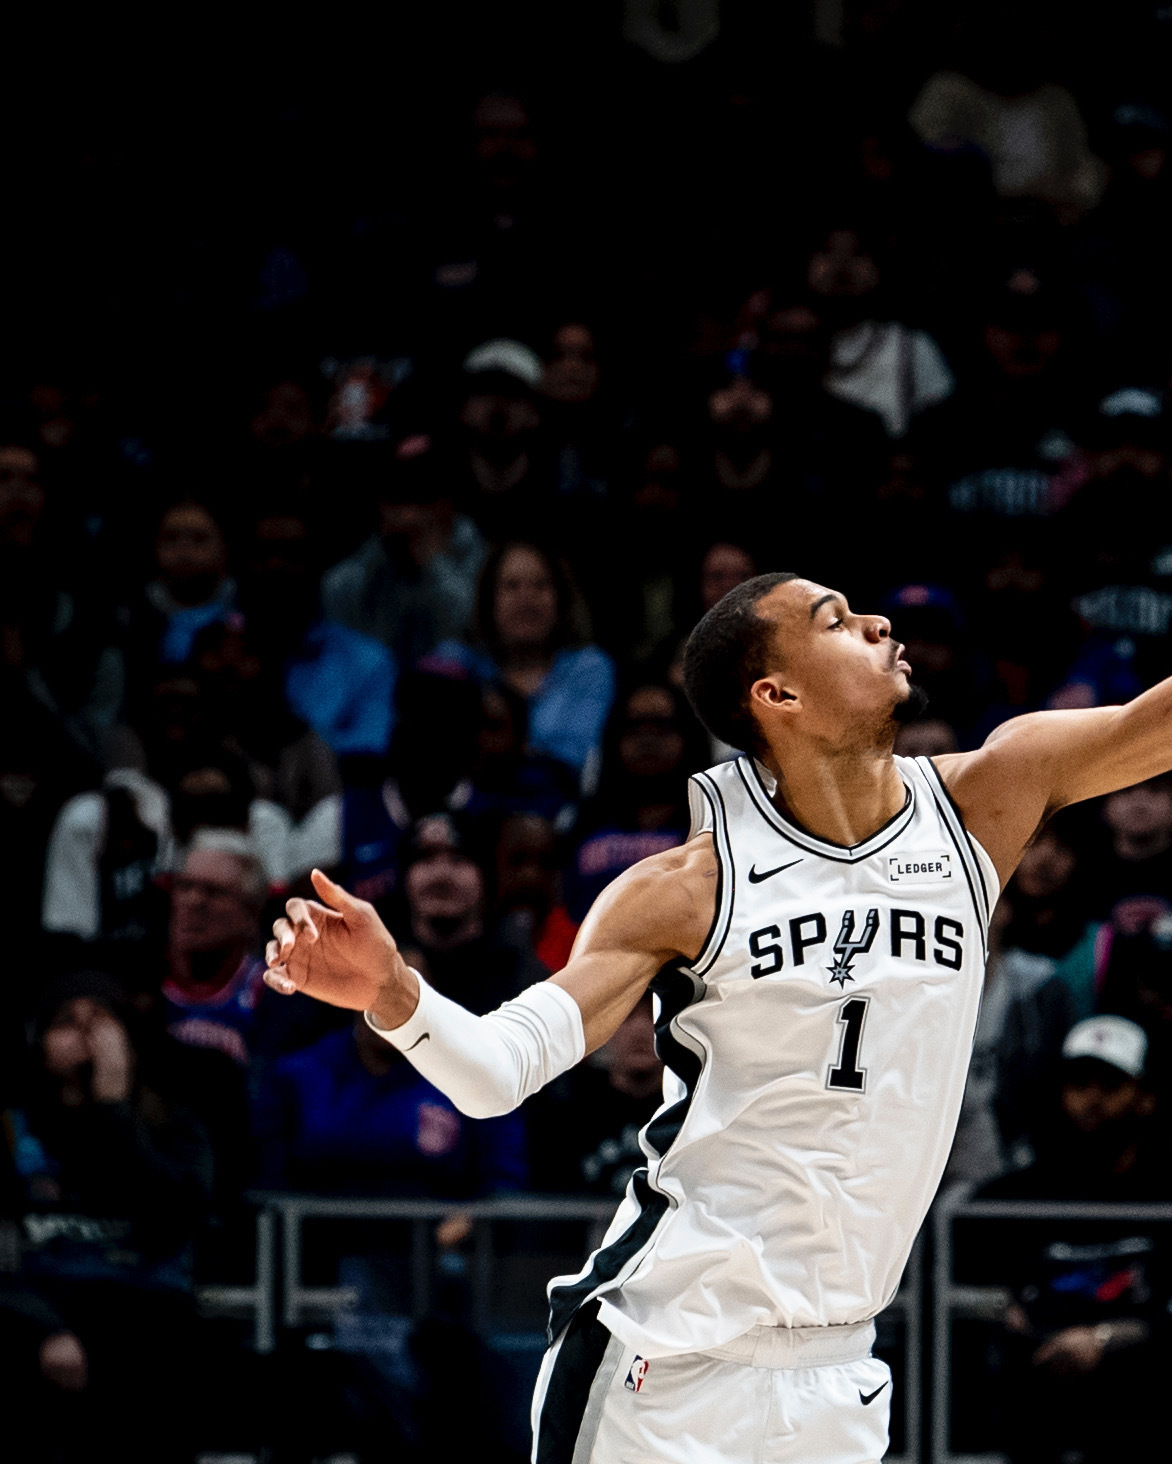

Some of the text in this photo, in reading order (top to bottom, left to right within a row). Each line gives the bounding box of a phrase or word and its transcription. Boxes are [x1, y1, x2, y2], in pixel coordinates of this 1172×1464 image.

[897, 862, 943, 875] LEDGER
[748, 908, 964, 989] SPURS
[825, 995, 871, 1094] 1
